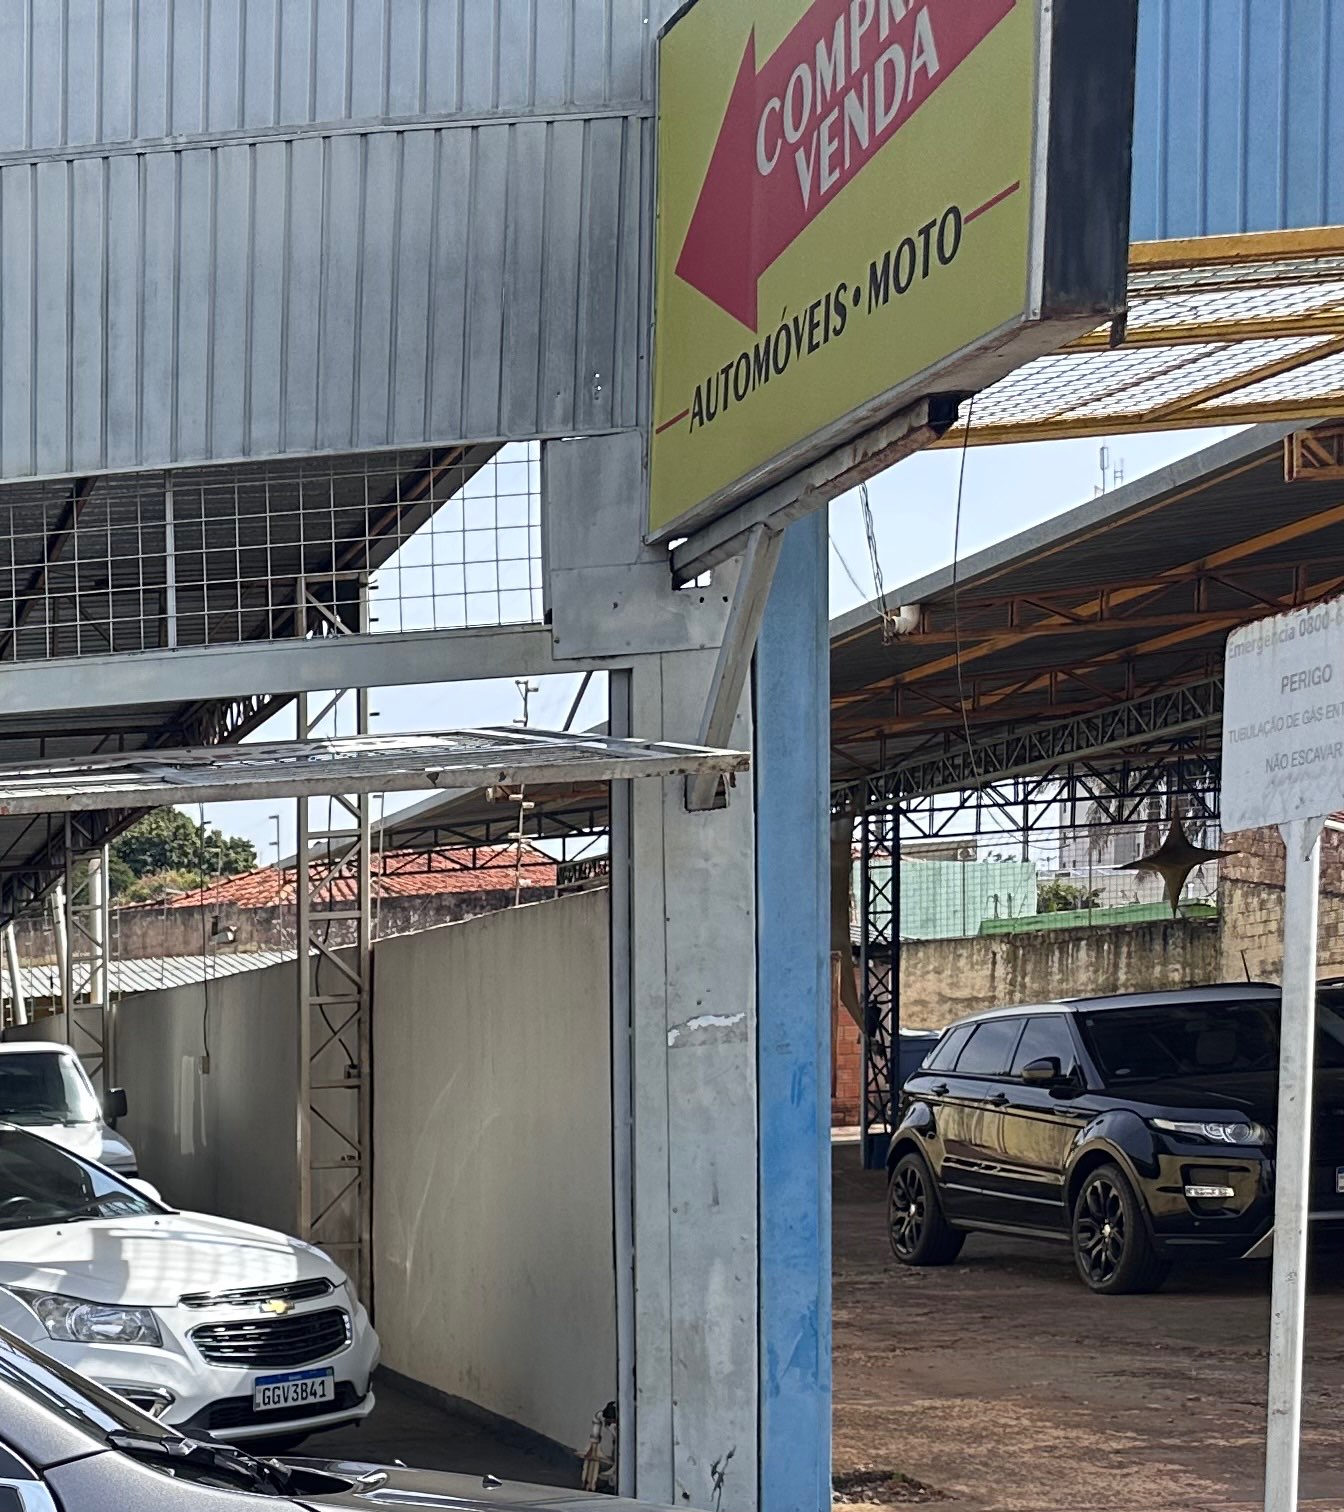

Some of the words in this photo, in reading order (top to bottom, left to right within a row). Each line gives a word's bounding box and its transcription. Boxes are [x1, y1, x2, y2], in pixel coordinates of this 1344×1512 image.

[756, 0, 913, 176] COMP
[795, 5, 940, 212] VENDA
[689, 282, 847, 434] AUTOMÓVEIS
[868, 205, 962, 314] MOTO
[1280, 663, 1333, 695] PERIGO
[1286, 712, 1301, 729] DE
[1265, 752, 1289, 774] NÃO
[1291, 741, 1343, 768] ESCAVAR
[262, 1379, 326, 1406] GGV3B41
